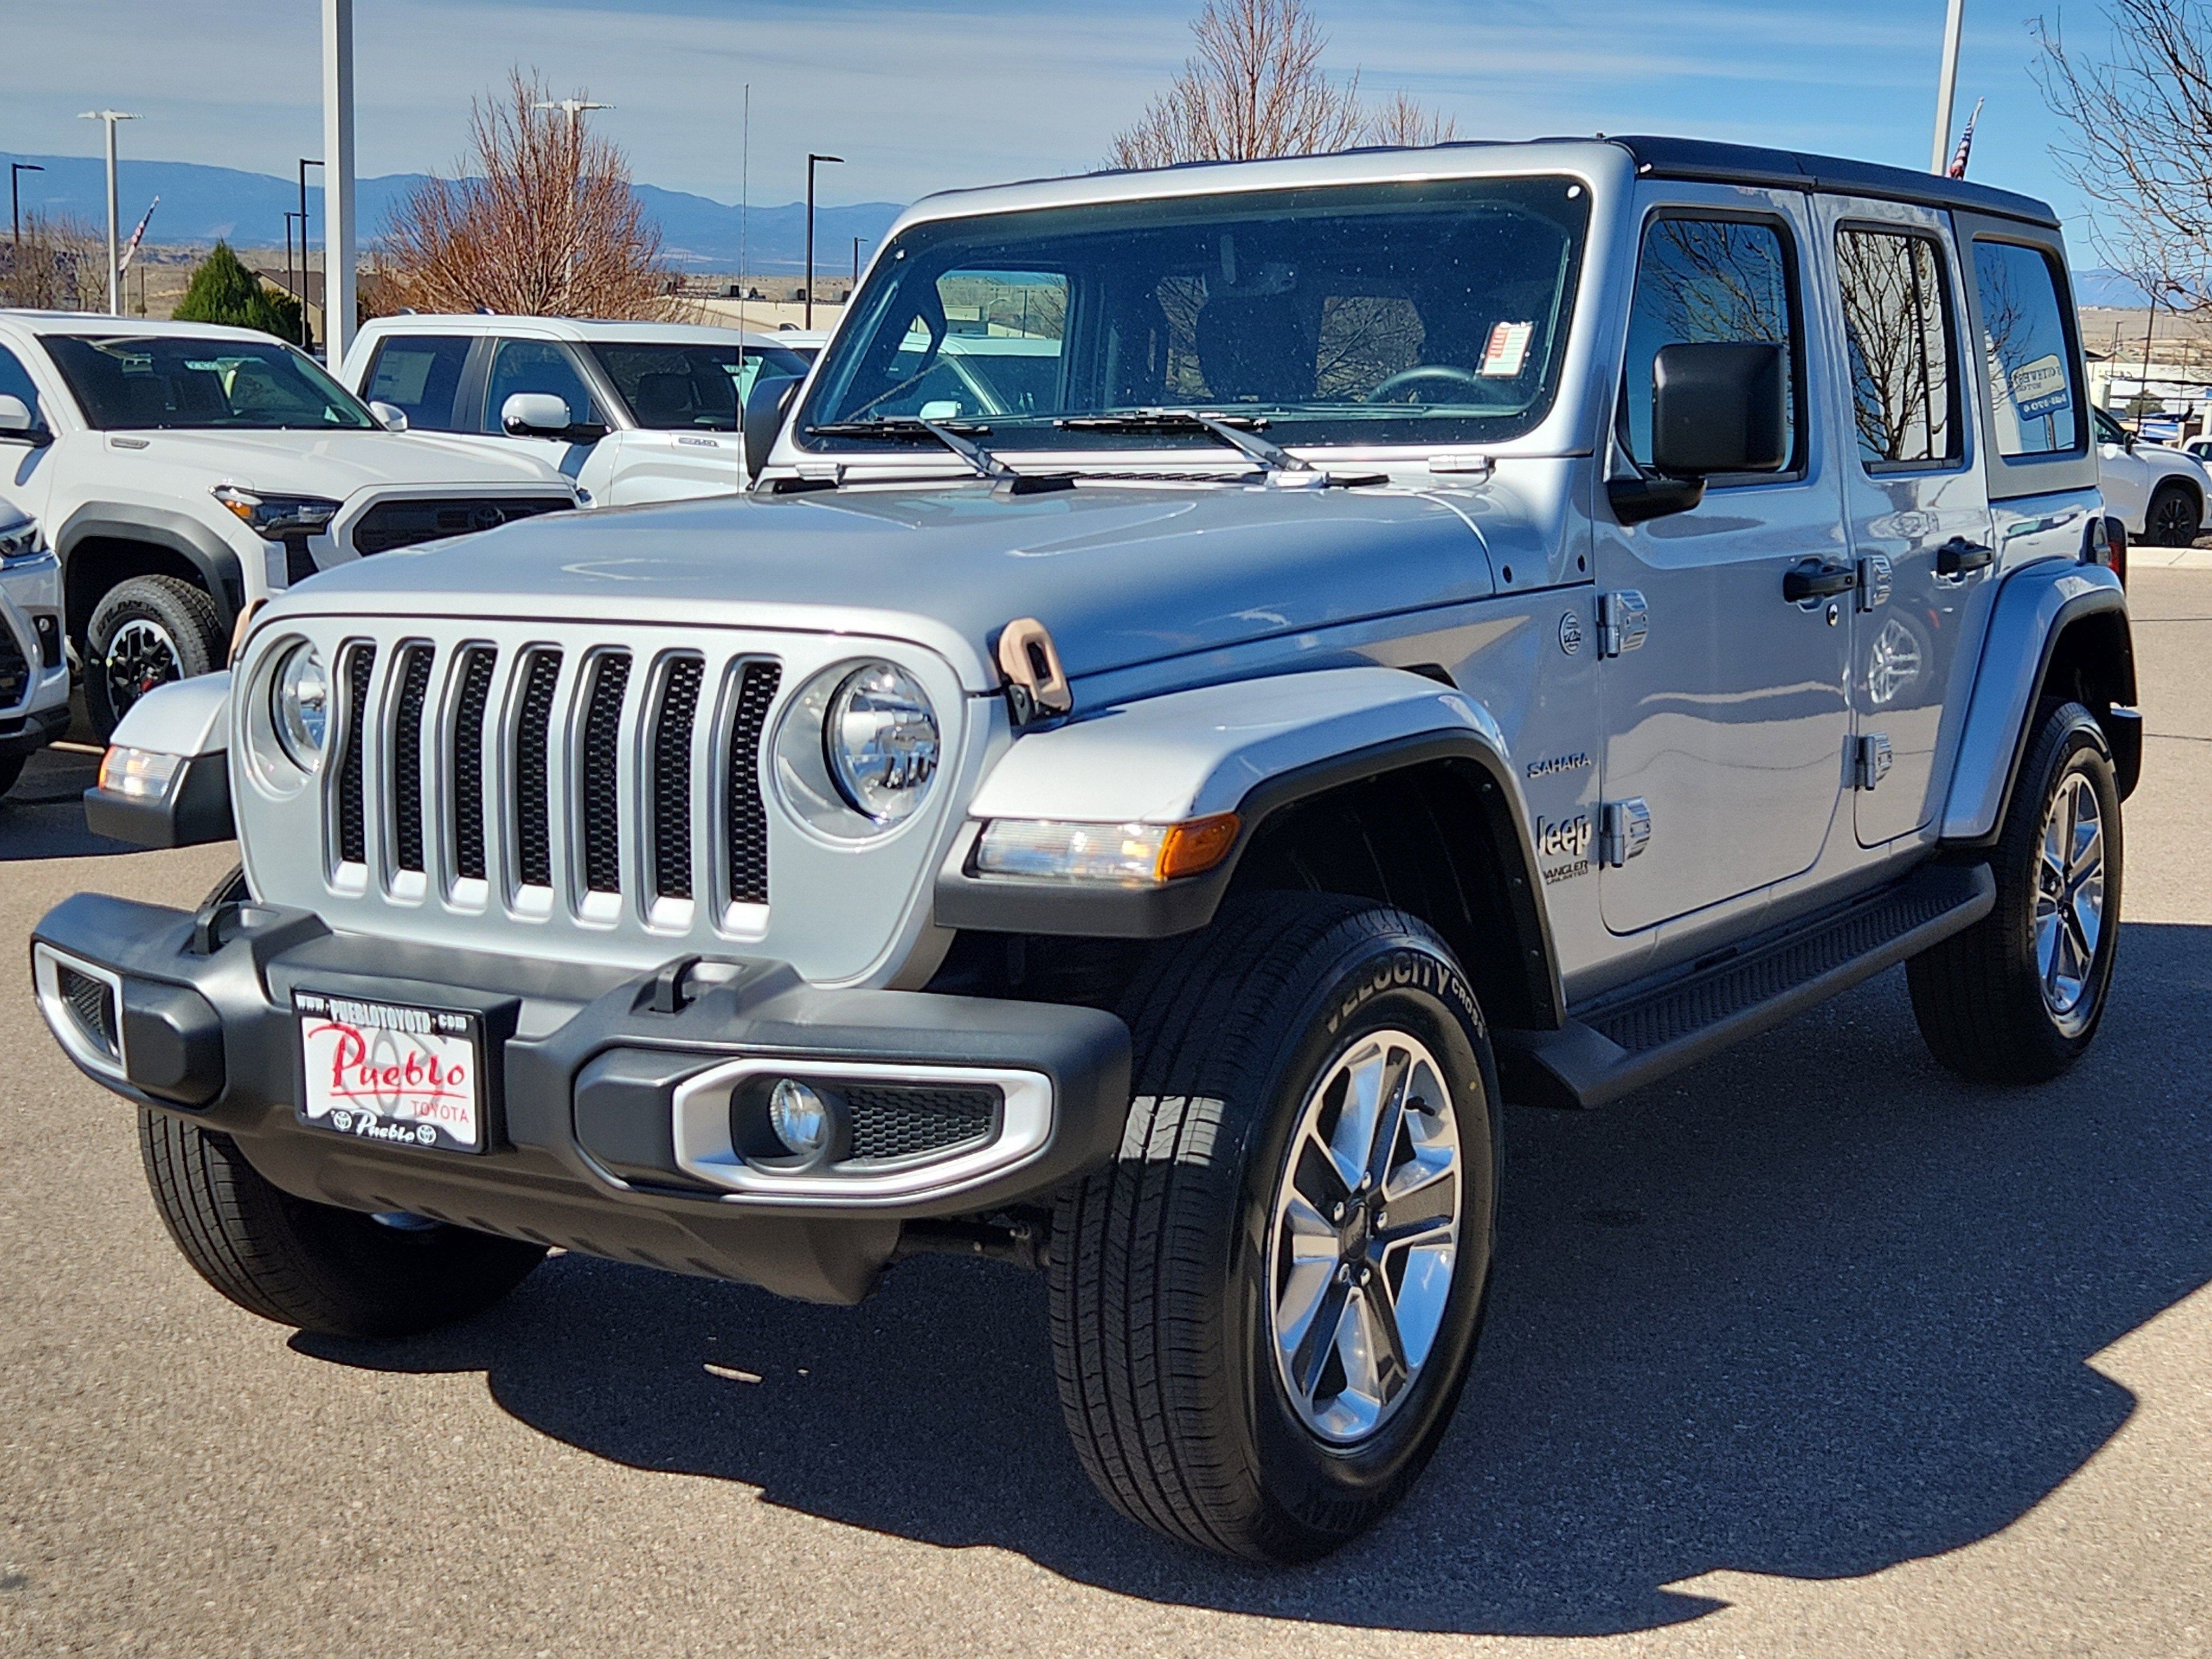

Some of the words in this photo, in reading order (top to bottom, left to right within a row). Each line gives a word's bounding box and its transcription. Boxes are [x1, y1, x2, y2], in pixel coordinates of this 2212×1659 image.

[1527, 752, 1592, 779] SAHARA
[1536, 814, 1592, 857] Jeep
[1543, 859, 1588, 879] ANGLER
[308, 1023, 465, 1089] Pueblo
[351, 1109, 415, 1143] Pueblo
[411, 1099, 469, 1123] TOYOTA
